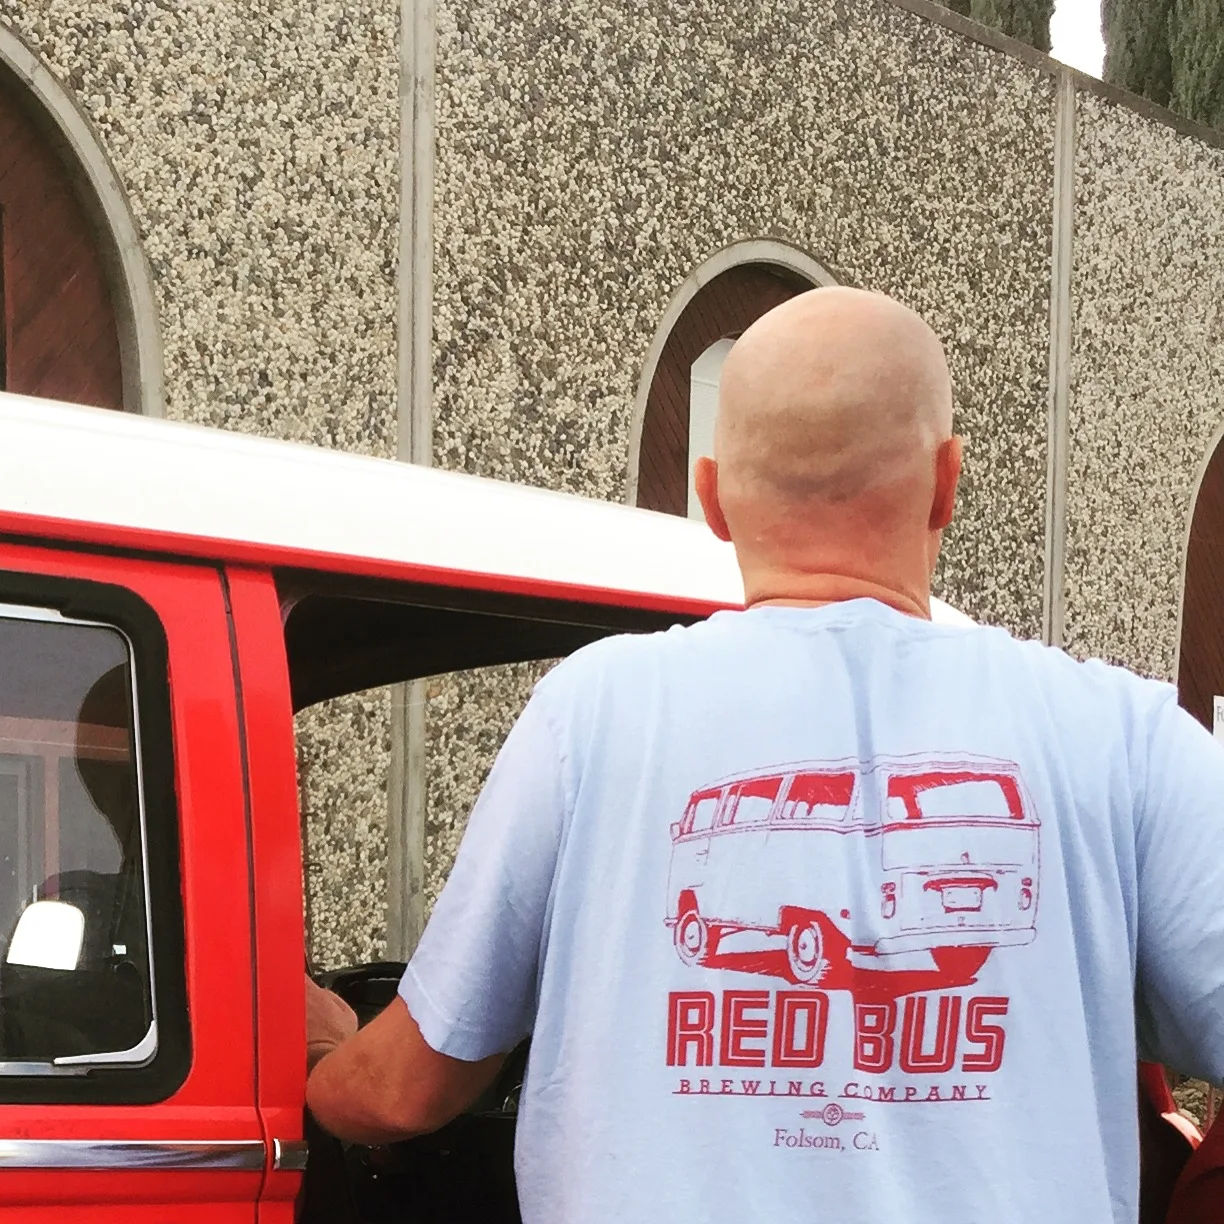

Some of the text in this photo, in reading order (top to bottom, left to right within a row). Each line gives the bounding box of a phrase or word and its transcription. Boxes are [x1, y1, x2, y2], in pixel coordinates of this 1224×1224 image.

[666, 990, 1010, 1074] RED BUS
[678, 1079, 988, 1101] BREWING COMPANY
[773, 1127, 880, 1153] Folsom, CA
